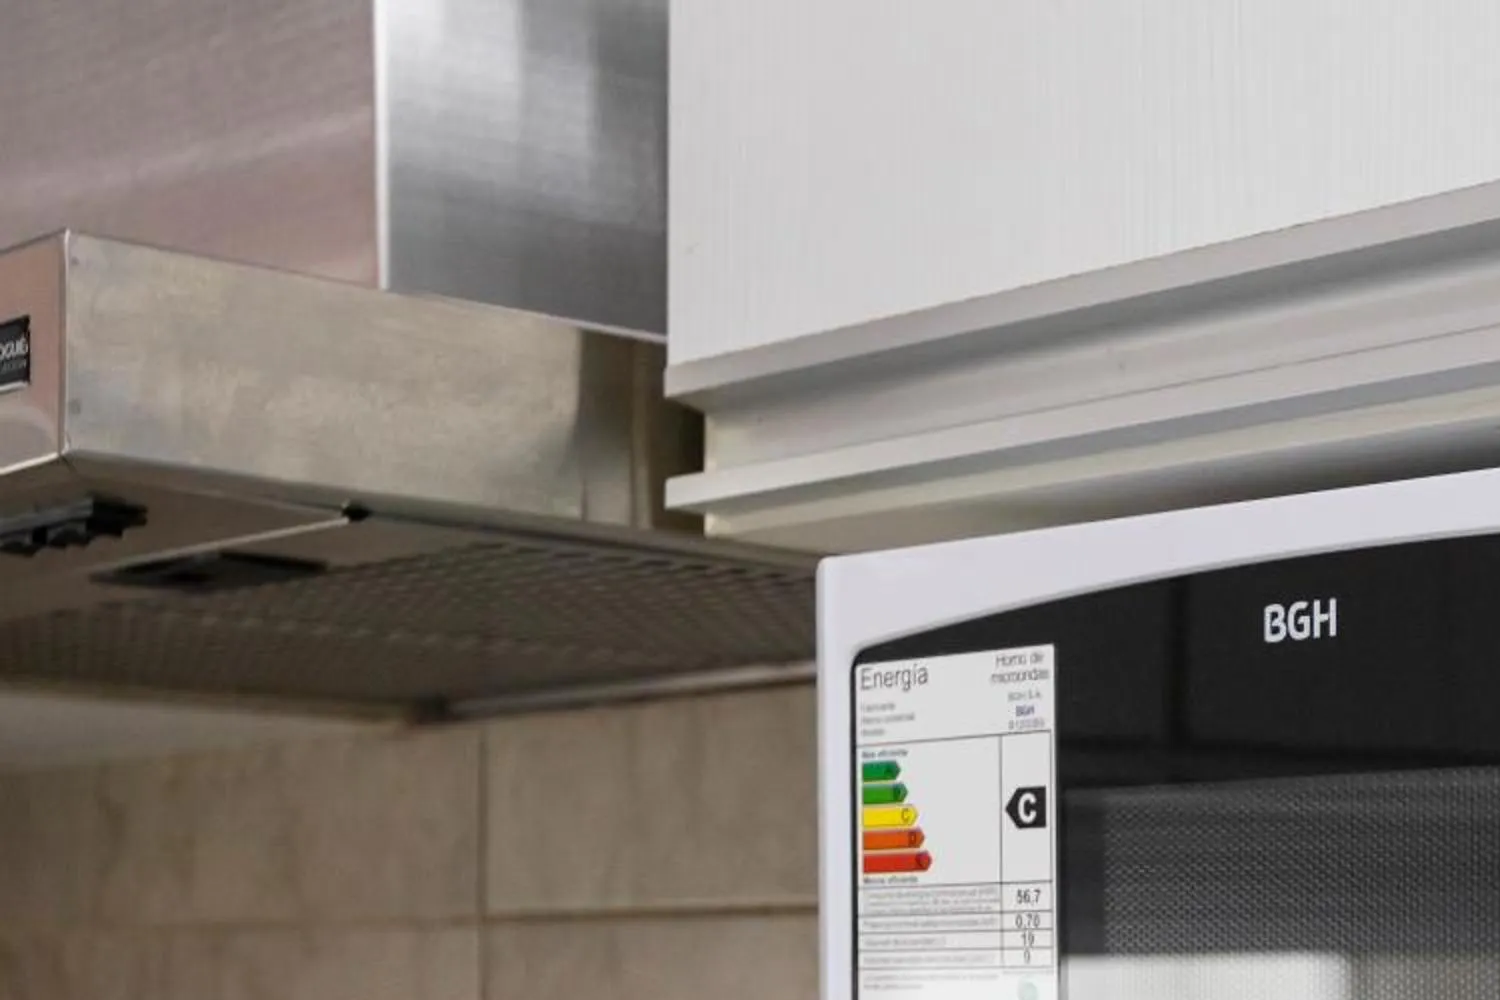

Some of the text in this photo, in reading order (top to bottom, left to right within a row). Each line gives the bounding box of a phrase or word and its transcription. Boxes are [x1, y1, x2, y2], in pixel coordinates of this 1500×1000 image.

[1263, 597, 1337, 643] BGH
[860, 664, 930, 692] Energía
[901, 808, 912, 823] C
[1018, 791, 1037, 824] C
